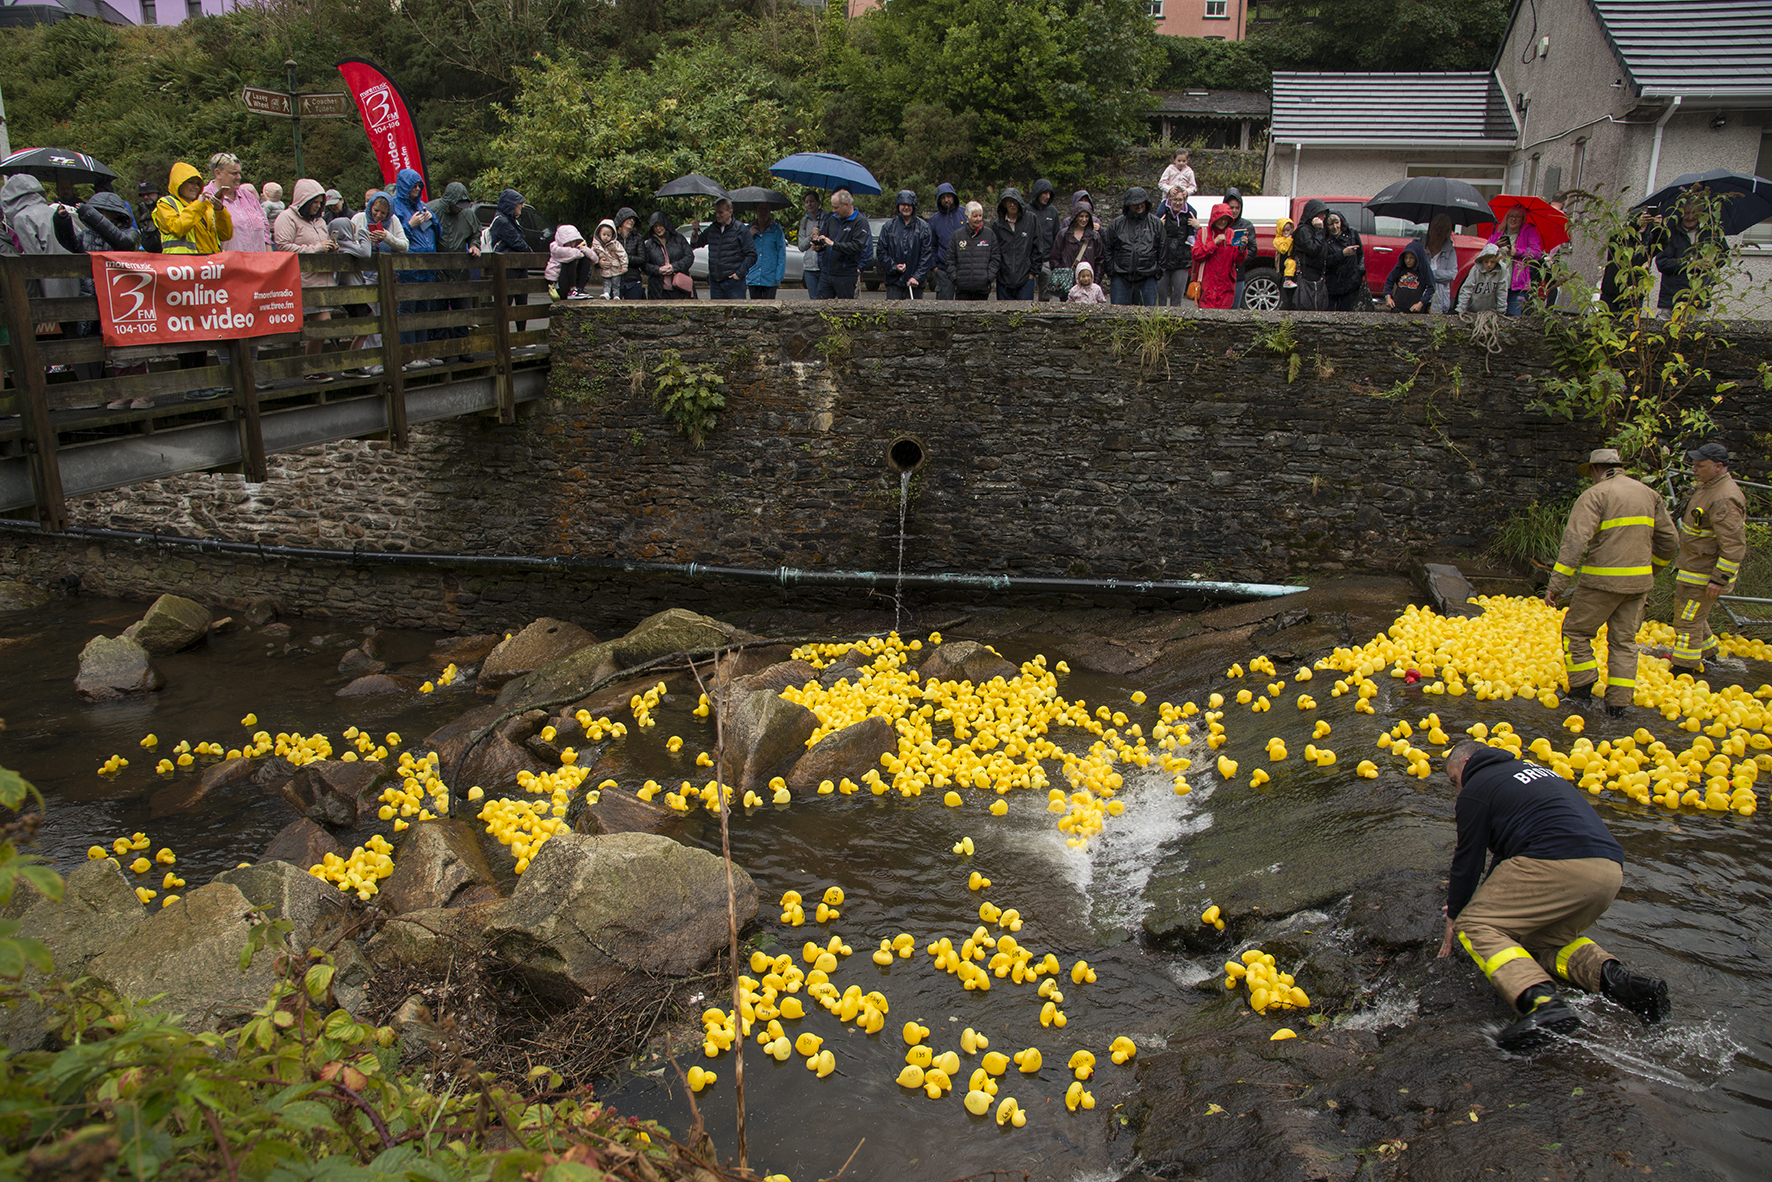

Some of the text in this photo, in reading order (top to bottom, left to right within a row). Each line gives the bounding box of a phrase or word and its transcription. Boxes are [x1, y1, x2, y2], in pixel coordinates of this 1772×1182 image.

[252, 92, 268, 102] Laxey
[253, 100, 269, 109] Wheel
[366, 90, 399, 127] 3 FM
[373, 120, 400, 134] 104-106
[387, 132, 401, 170] video
[106, 260, 153, 270] moremusic
[166, 261, 225, 281] on air
[112, 272, 155, 322] 3 FM
[166, 283, 229, 306] online
[259, 301, 295, 311] www.three.fm
[167, 307, 254, 332] on video
[114, 323, 157, 335] 104-106
